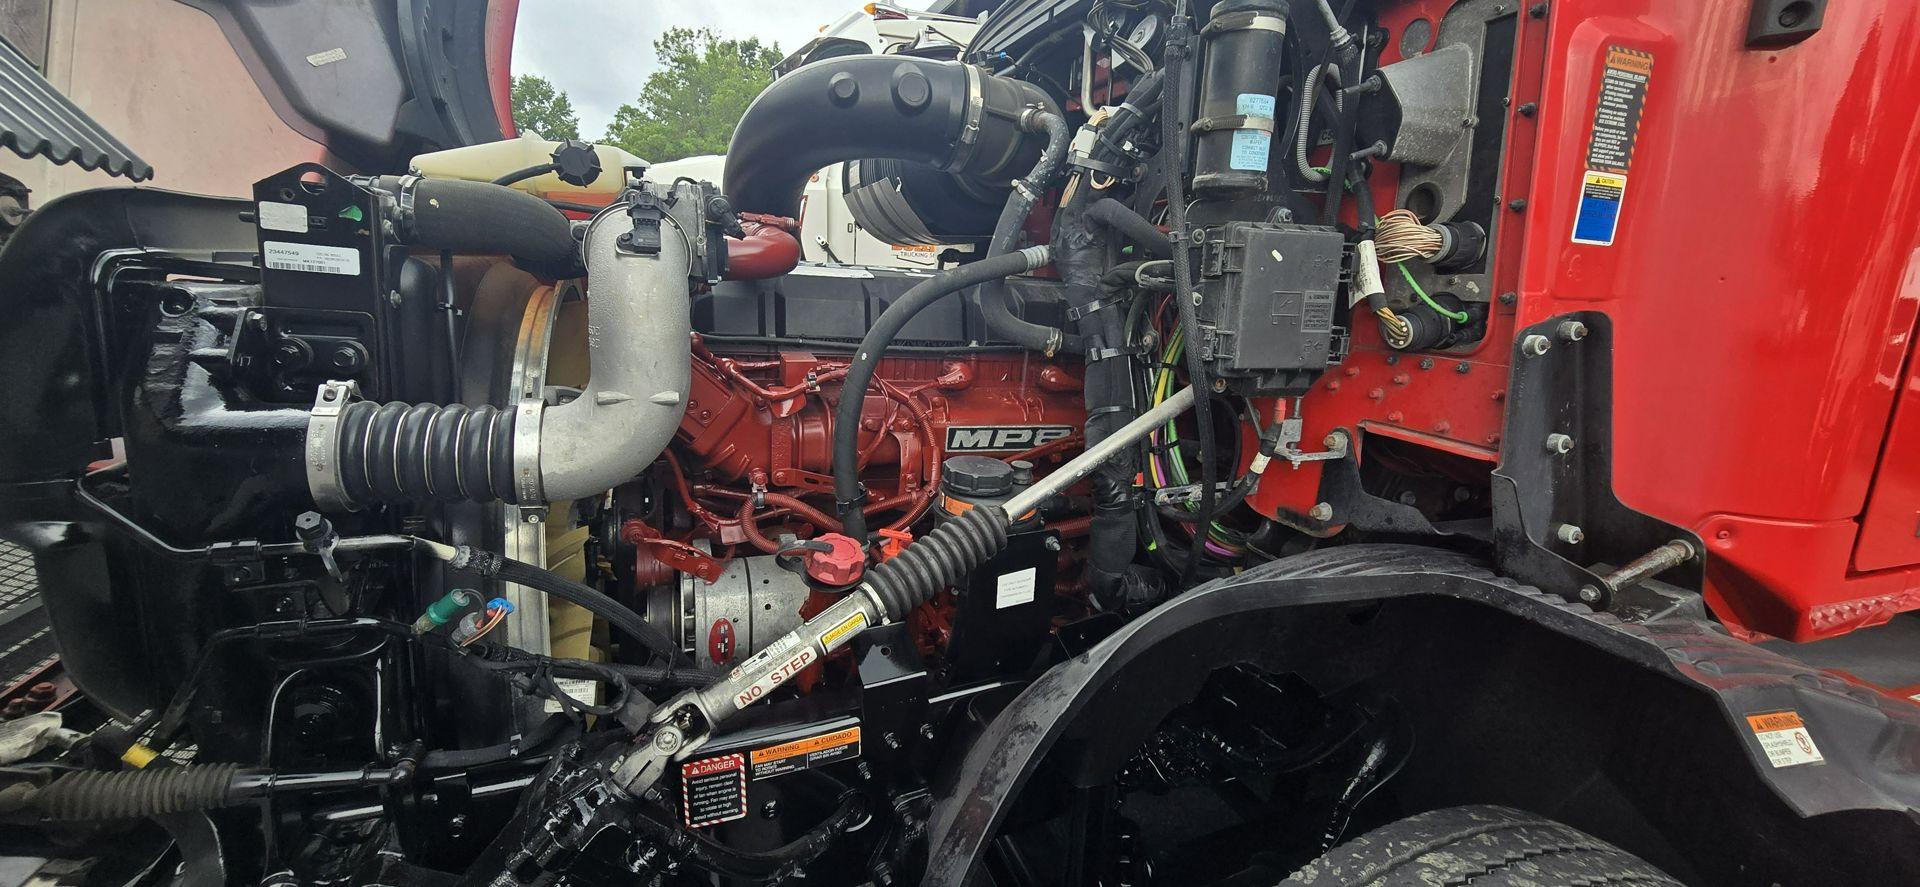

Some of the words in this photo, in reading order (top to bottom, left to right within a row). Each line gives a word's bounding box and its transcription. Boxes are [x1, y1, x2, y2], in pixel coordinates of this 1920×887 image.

[1615, 56, 1649, 71] WARNING
[739, 685, 763, 705] NO
[770, 651, 811, 684] STEP
[1763, 715, 1799, 729] WARNING
[821, 731, 852, 744] CUIDADO
[765, 744, 800, 756] WARNING
[701, 760, 735, 773] DANGER
[720, 772, 737, 780] personal
